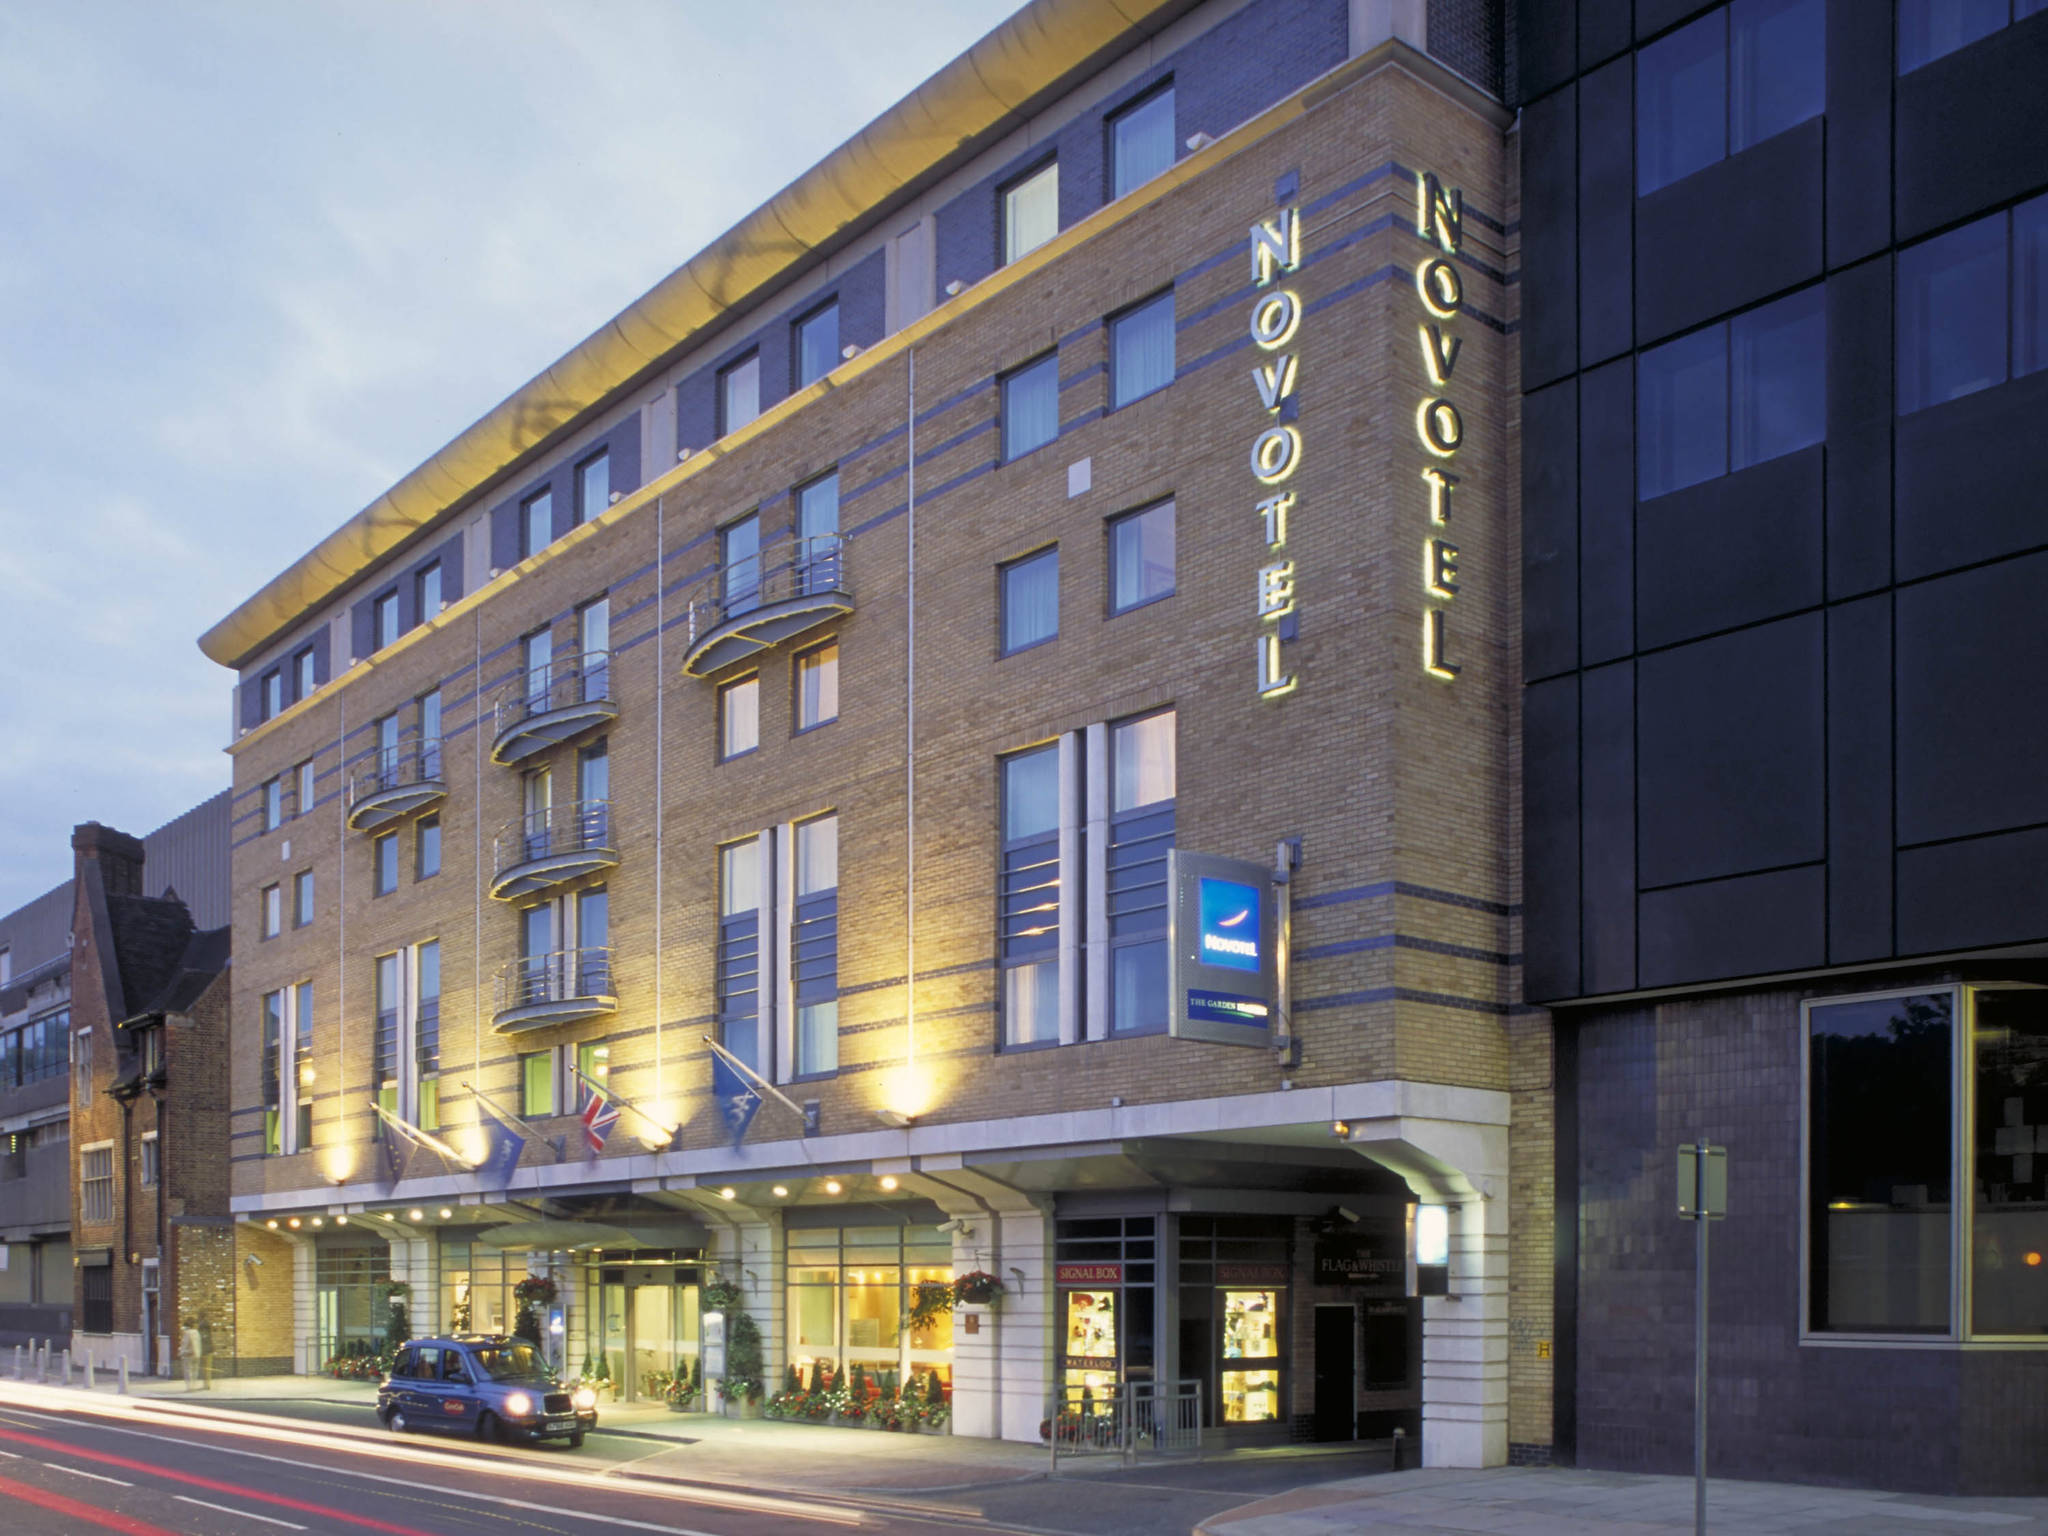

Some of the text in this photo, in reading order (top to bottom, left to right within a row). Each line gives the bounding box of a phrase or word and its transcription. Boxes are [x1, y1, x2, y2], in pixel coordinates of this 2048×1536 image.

[1416, 171, 1464, 680] NOVOTEL
[1249, 208, 1301, 698] NOVOTEL
[1204, 934, 1257, 956] NOVOTEL
[1190, 998, 1206, 1007] THE
[1207, 1000, 1236, 1009] GARDEN
[1060, 1267, 1118, 1279] SIGNAL BOX
